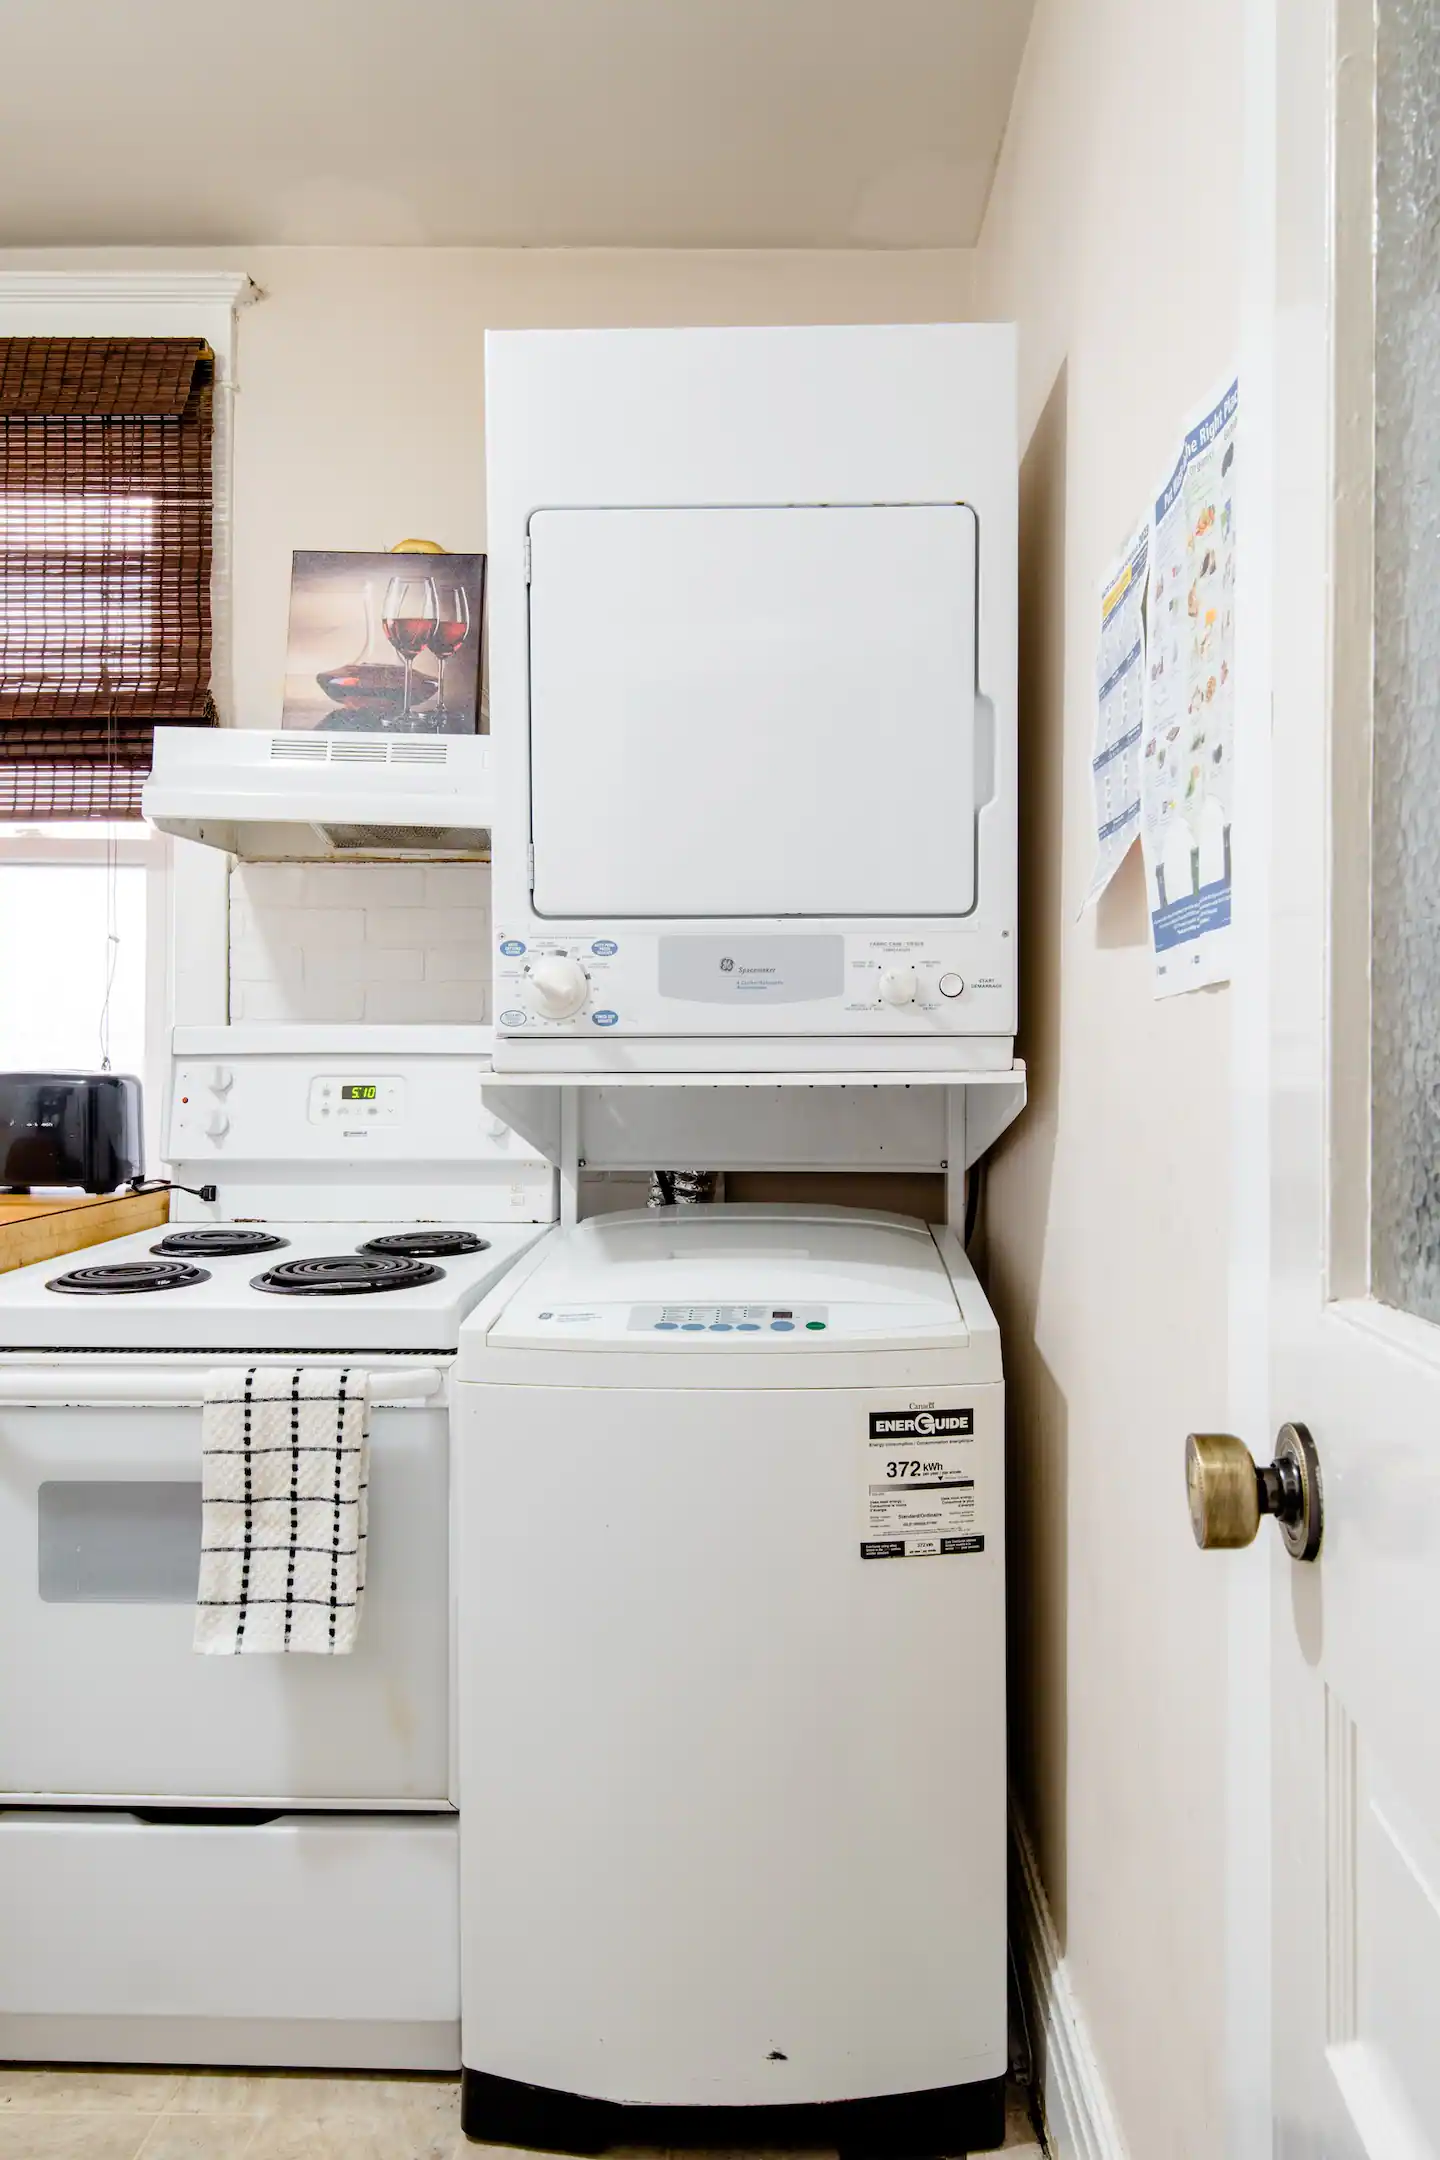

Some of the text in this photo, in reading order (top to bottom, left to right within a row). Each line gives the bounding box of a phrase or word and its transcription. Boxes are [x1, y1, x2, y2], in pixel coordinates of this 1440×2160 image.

[1199, 410, 1223, 446] Right
[886, 1460, 943, 1478] 372 kWh
